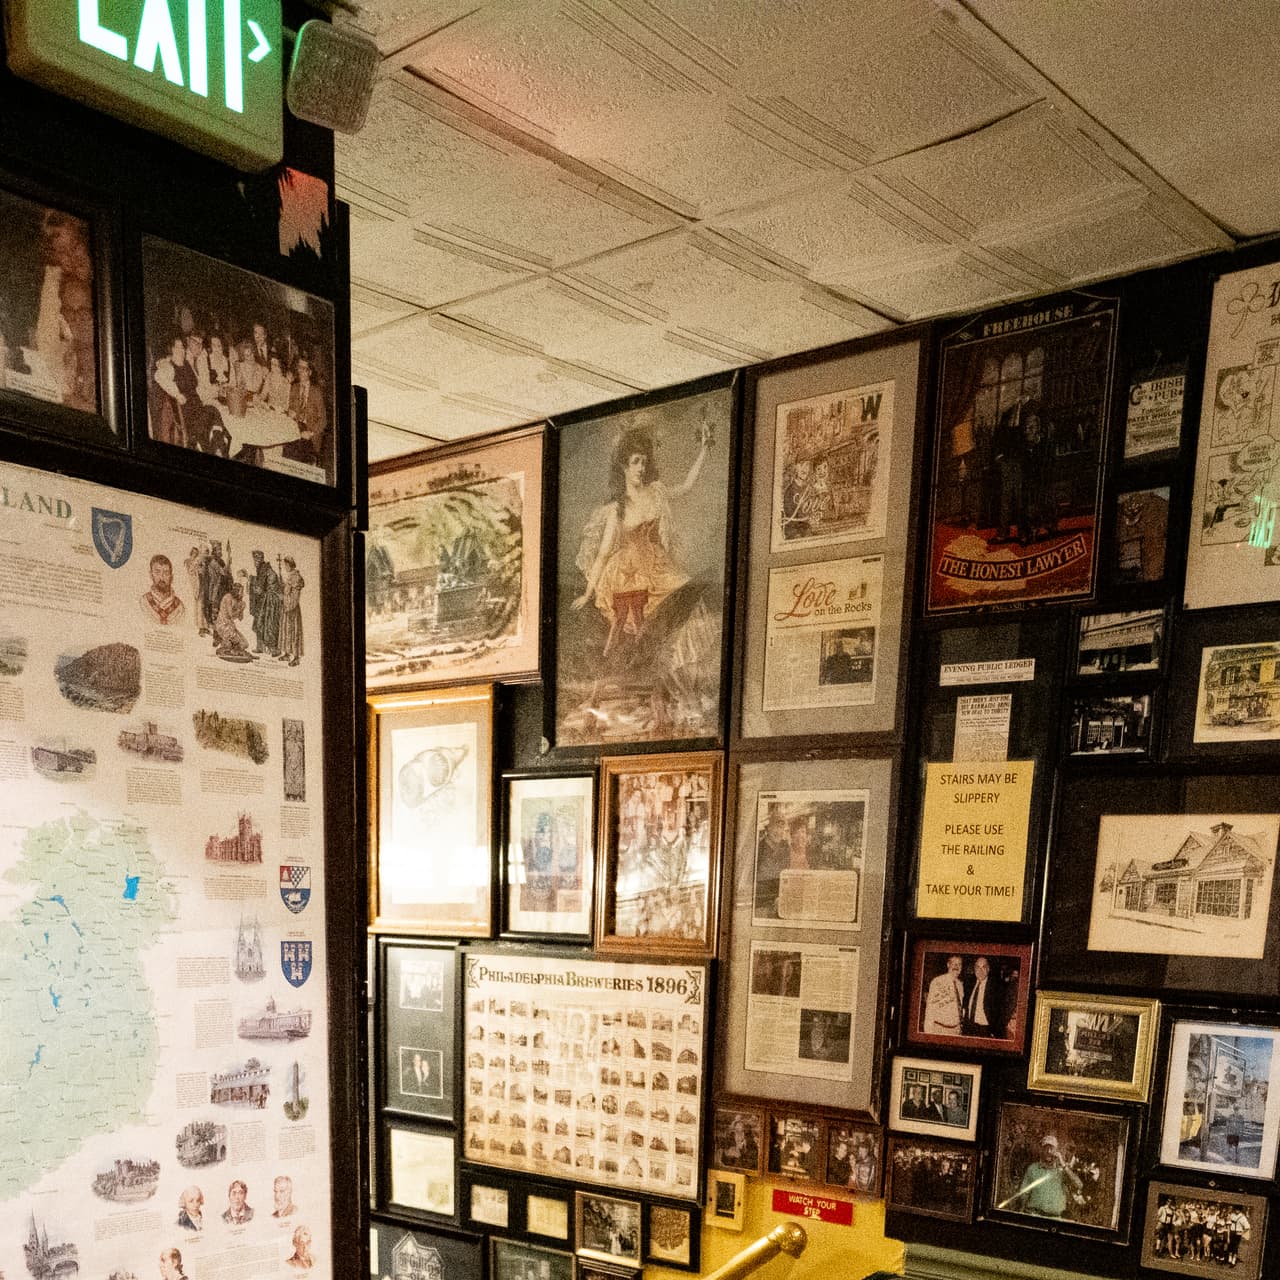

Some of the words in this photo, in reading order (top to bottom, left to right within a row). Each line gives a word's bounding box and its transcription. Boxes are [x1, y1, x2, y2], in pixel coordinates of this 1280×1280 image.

[1151, 377, 1184, 391] IRISH
[1154, 388, 1179, 401] PUB
[941, 556, 968, 577] THE
[969, 560, 1024, 581] HONEST
[1025, 538, 1086, 576] LAWYER
[774, 576, 836, 622] Love
[827, 604, 843, 616] the
[844, 601, 873, 614] Rocks
[944, 664, 975, 674] EVENING
[977, 662, 1004, 672] PUBLIC
[1004, 660, 1033, 670] LEDGER
[940, 774, 975, 785] STAIRS
[977, 773, 1002, 785] MAY
[1004, 773, 1017, 784] BE
[954, 792, 1000, 804] SLIPPERY
[945, 824, 981, 835] PLEASE
[984, 824, 1004, 835] USE
[941, 844, 961, 855] THE
[963, 844, 1004, 856] RAILING
[966, 864, 975, 876] &
[926, 884, 950, 895] TAKE
[953, 884, 982, 896] YOUR
[985, 885, 1015, 897] TIME!
[478, 965, 565, 986] PHILADELPHIA
[566, 971, 644, 993] BREWERIES
[646, 975, 689, 996] 1896
[788, 1193, 814, 1206] WATCH
[816, 1200, 837, 1211] YOUR
[803, 1206, 821, 1216] STEP
